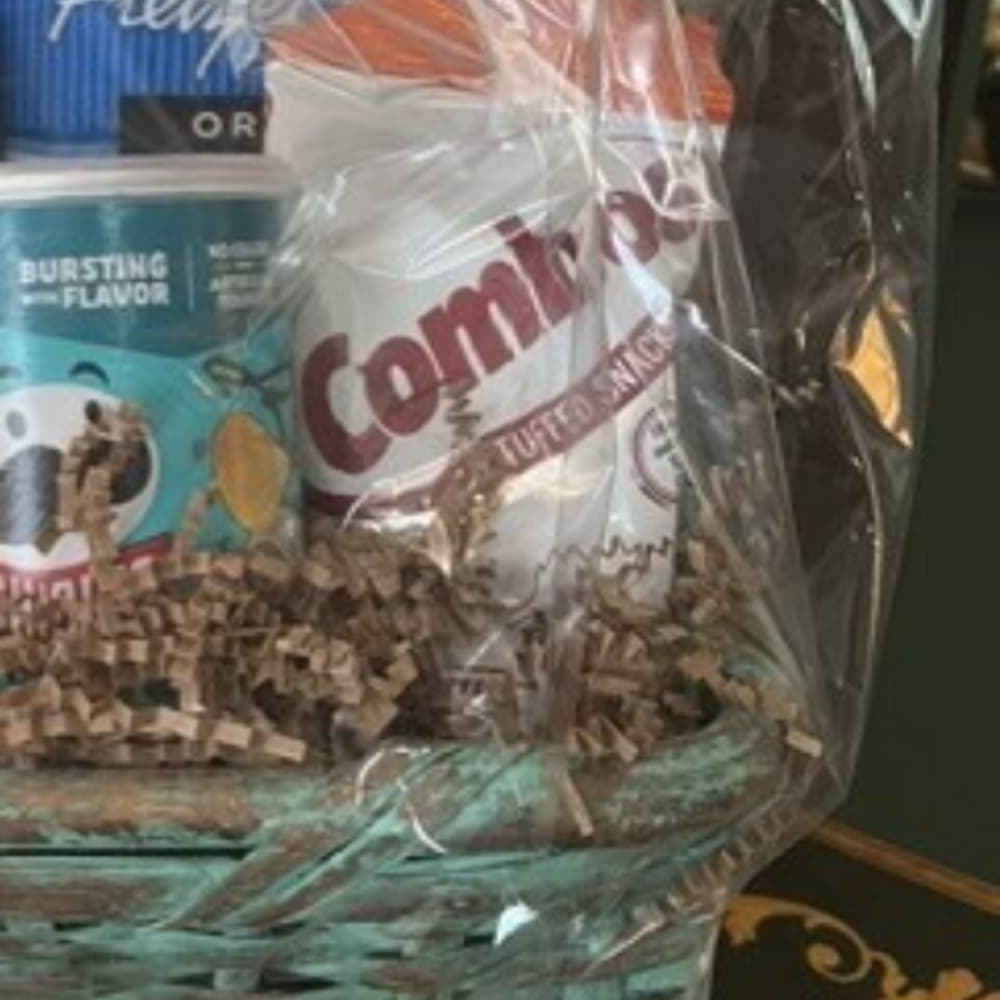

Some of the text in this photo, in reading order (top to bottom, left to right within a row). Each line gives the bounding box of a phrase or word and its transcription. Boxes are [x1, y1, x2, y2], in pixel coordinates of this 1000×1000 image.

[192, 110, 258, 140] OR
[19, 251, 169, 284] BURSTING
[62, 282, 170, 310] FLAVOR
[483, 393, 596, 476] TUFFED
